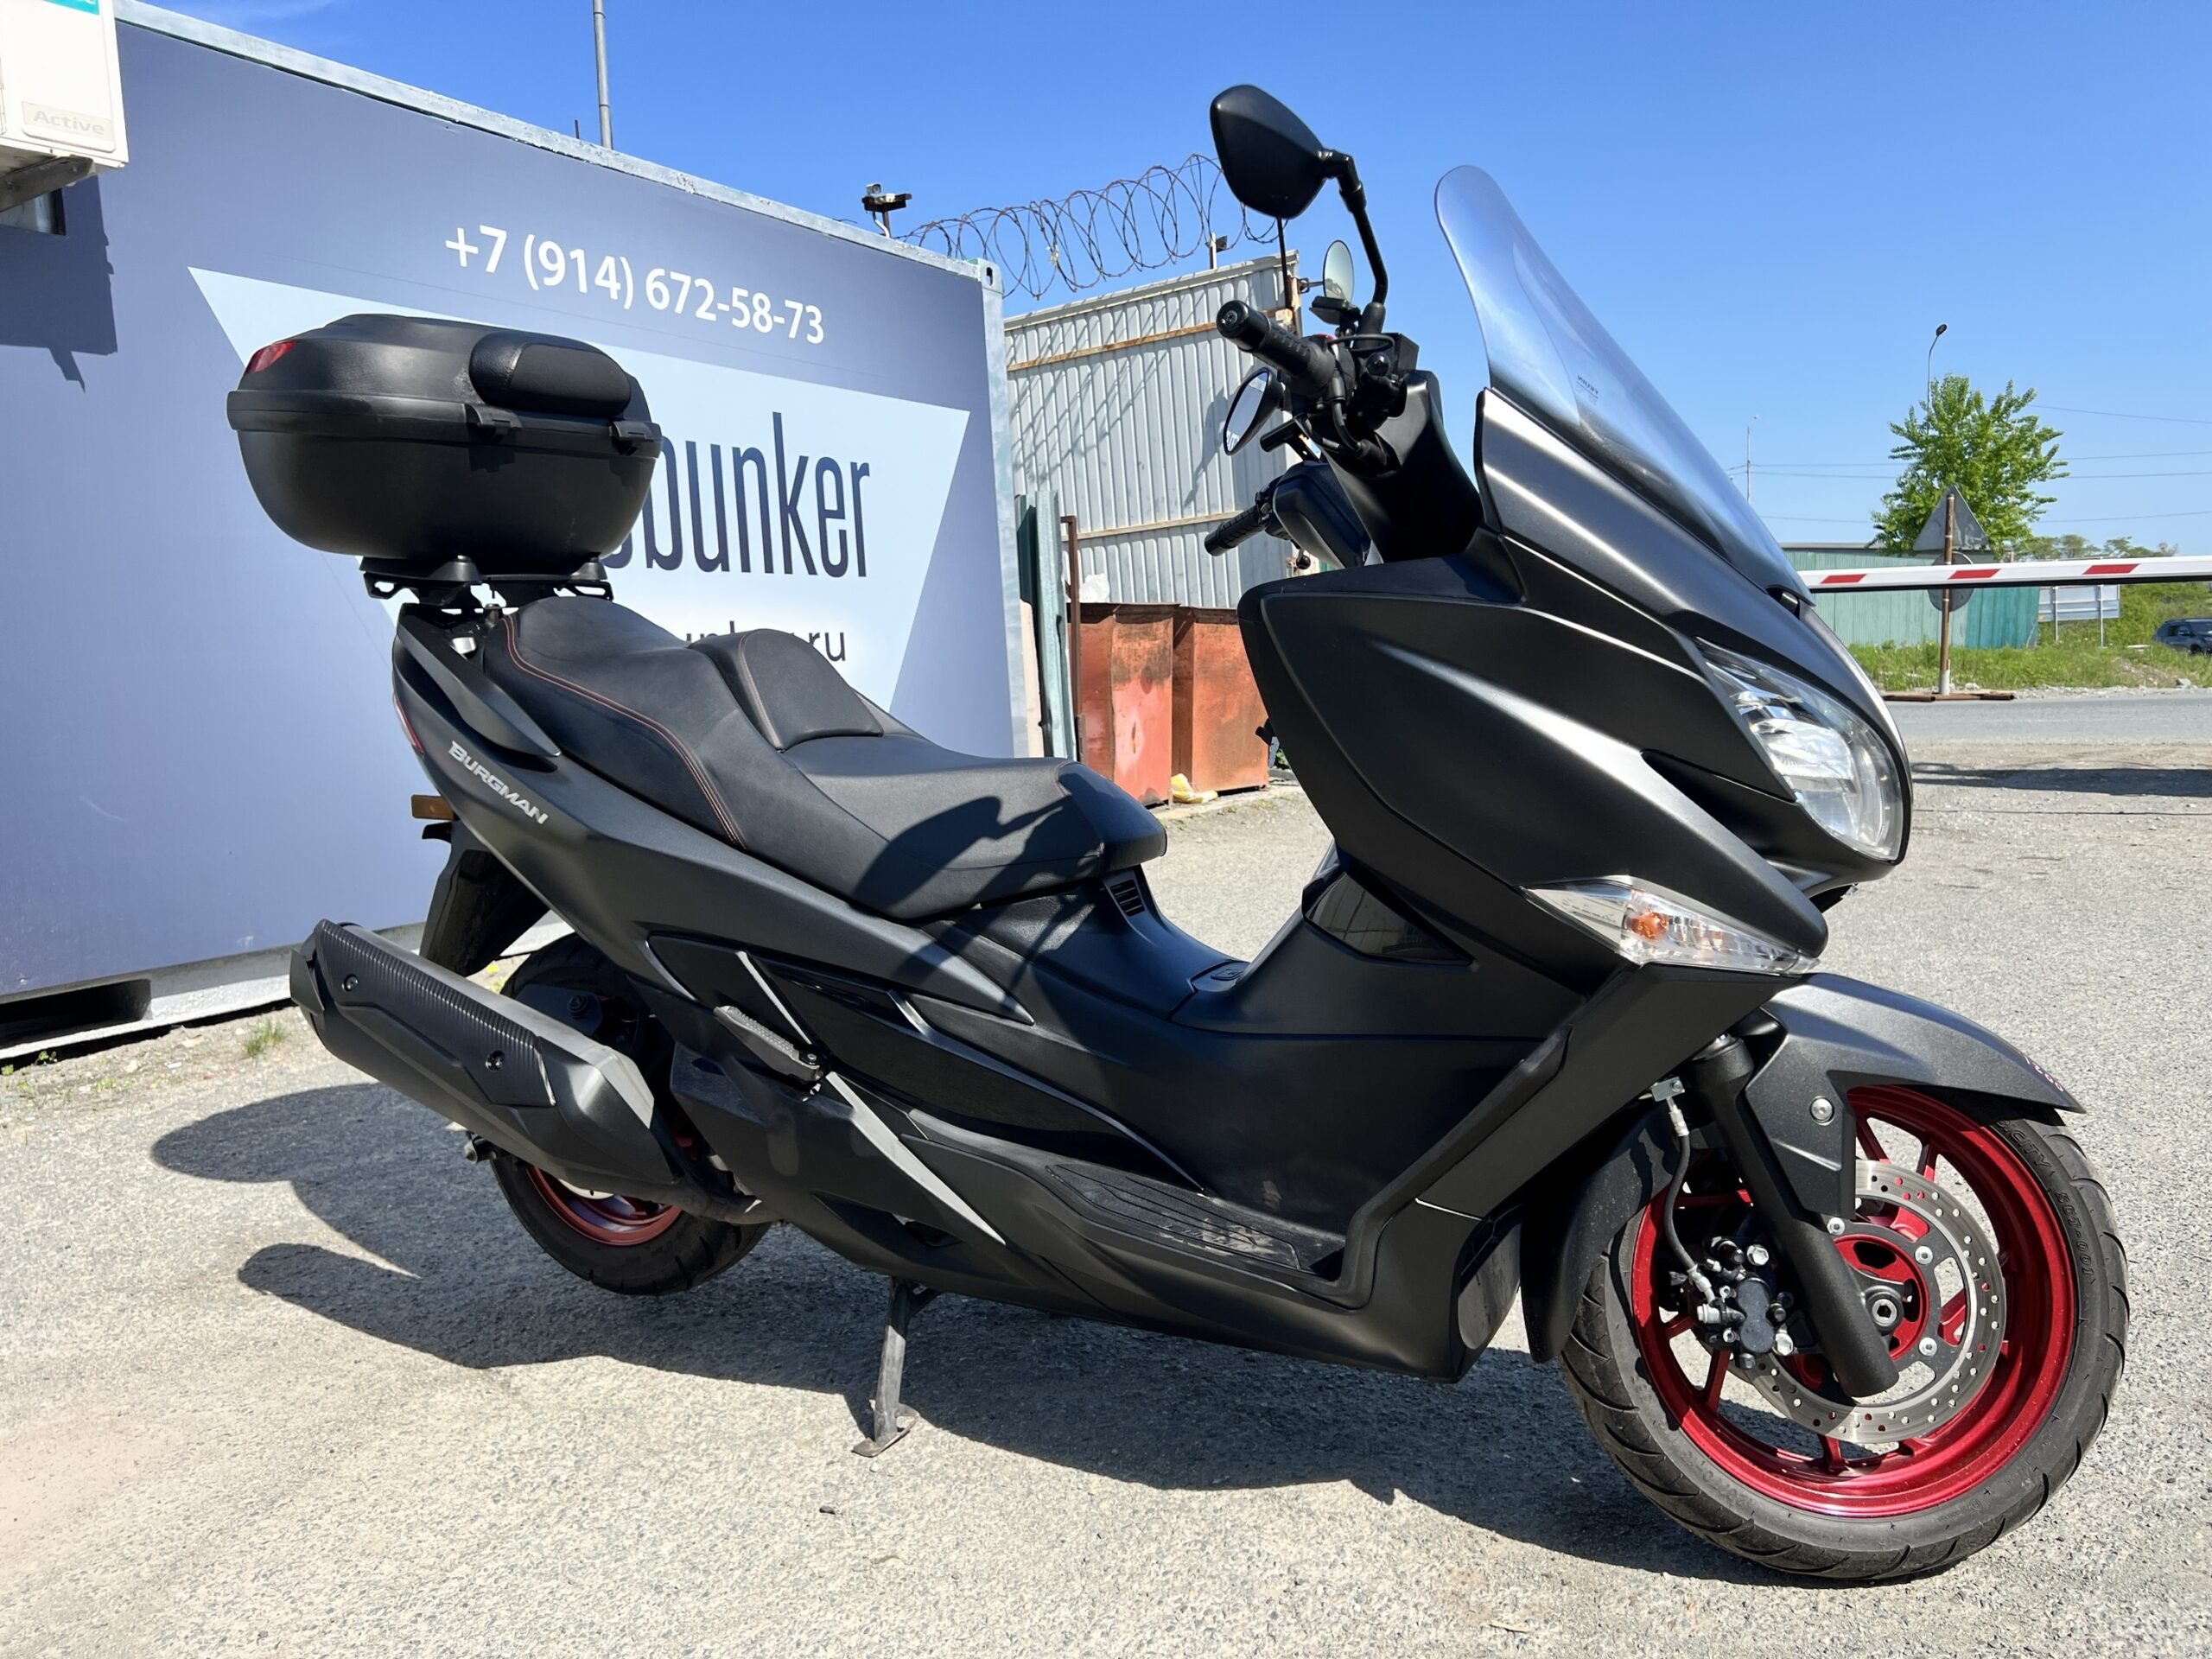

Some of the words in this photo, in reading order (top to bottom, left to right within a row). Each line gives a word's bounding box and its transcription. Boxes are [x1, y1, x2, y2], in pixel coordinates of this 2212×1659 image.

[33, 110, 105, 136] Active
[445, 225, 507, 273] +7
[524, 234, 634, 310] (914)
[645, 268, 824, 345] 672-58-73
[604, 411, 870, 578] bunker
[448, 741, 549, 824] BURGMAN
